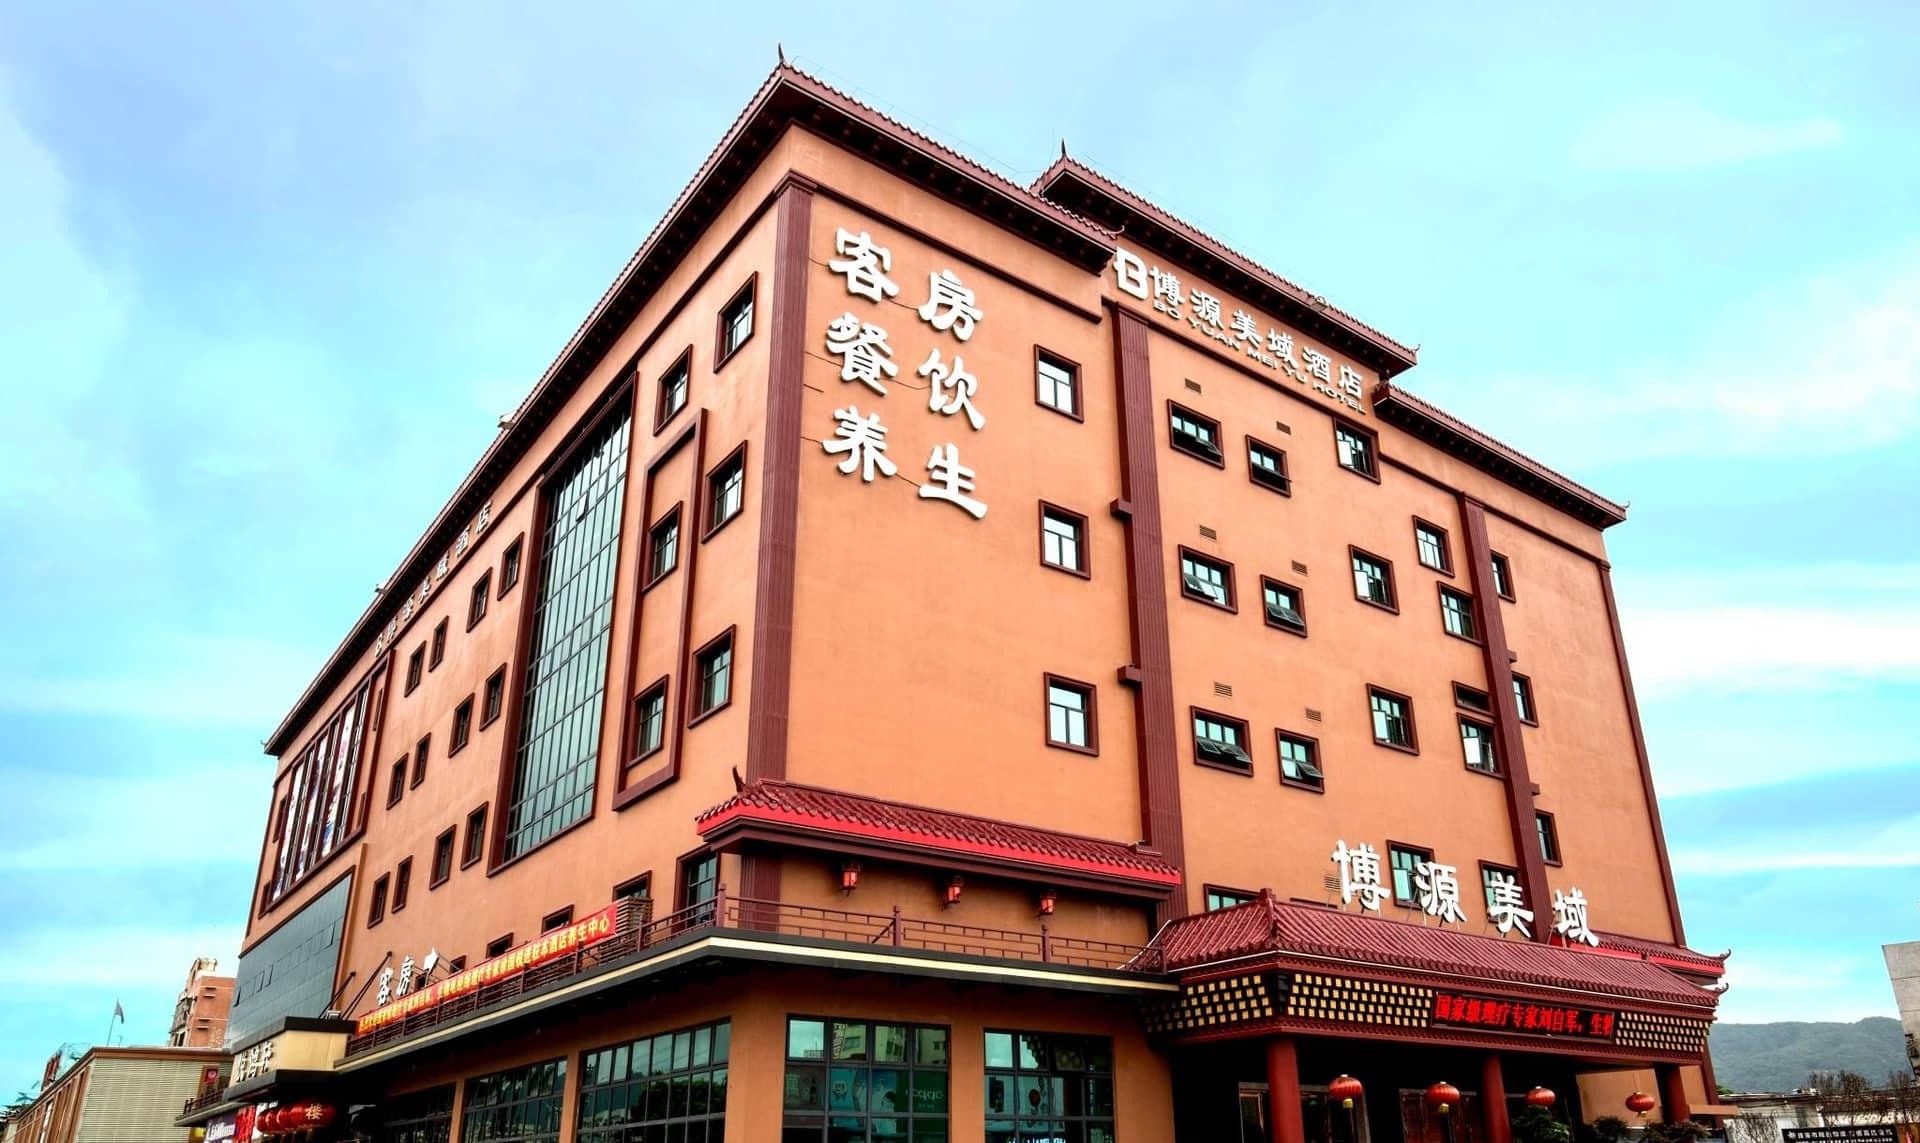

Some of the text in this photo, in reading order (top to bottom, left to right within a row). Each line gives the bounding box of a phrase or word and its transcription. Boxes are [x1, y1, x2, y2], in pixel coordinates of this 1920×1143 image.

[827, 228, 983, 342] 客房
[1148, 265, 1364, 399] 博源美域酒店
[826, 311, 987, 431] 餐饮
[1153, 299, 1368, 415] BO YUAN MEI YU HOTEL
[822, 404, 988, 520] 养生
[1330, 839, 1601, 948] 博源美域
